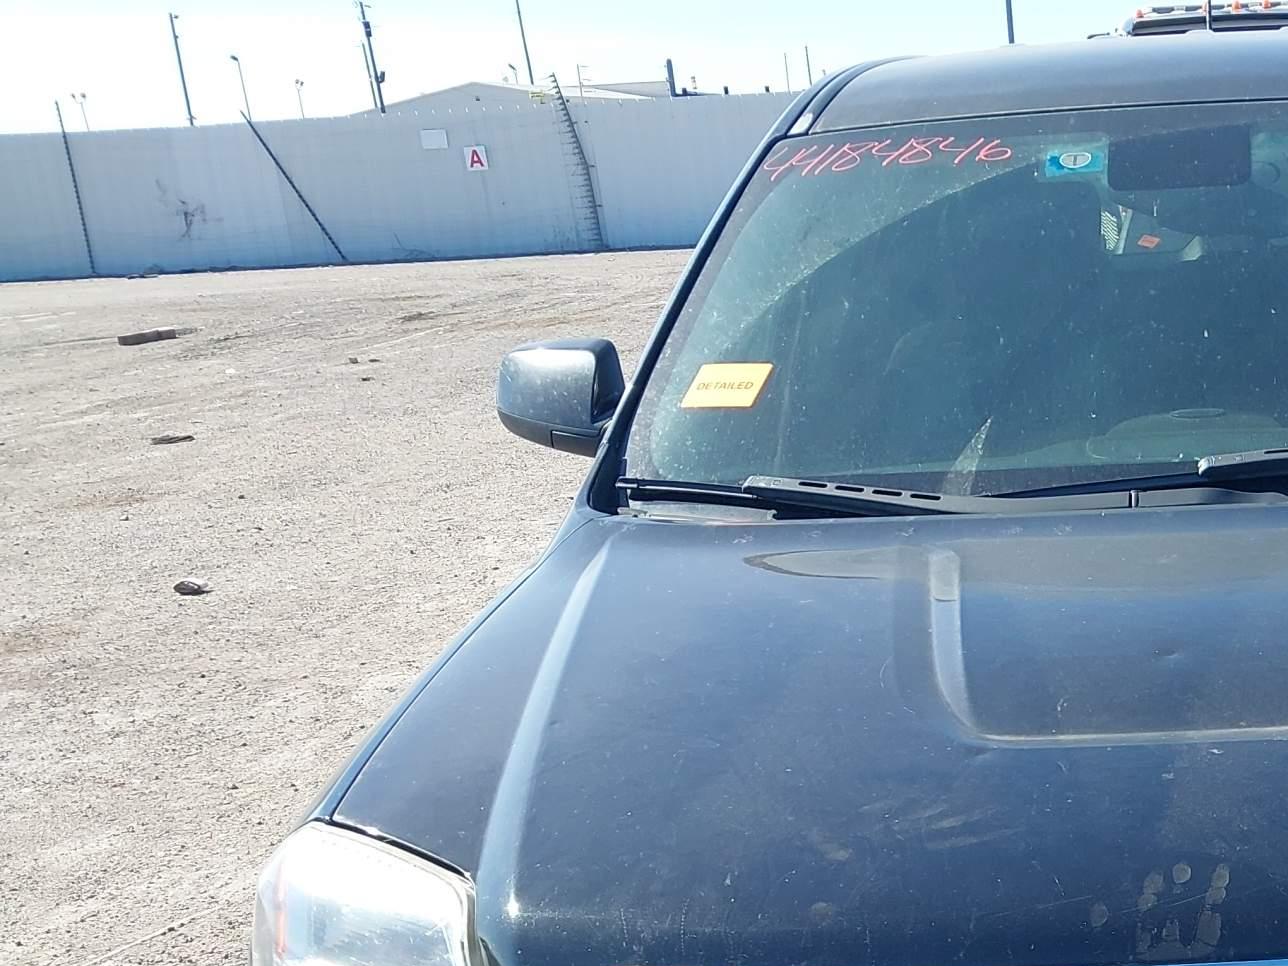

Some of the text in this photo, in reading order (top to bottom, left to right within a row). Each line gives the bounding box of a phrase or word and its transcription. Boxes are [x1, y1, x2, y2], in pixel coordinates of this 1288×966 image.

[469, 149, 484, 168] A
[763, 137, 1012, 181] 44184846
[696, 380, 754, 391] DETAILED
